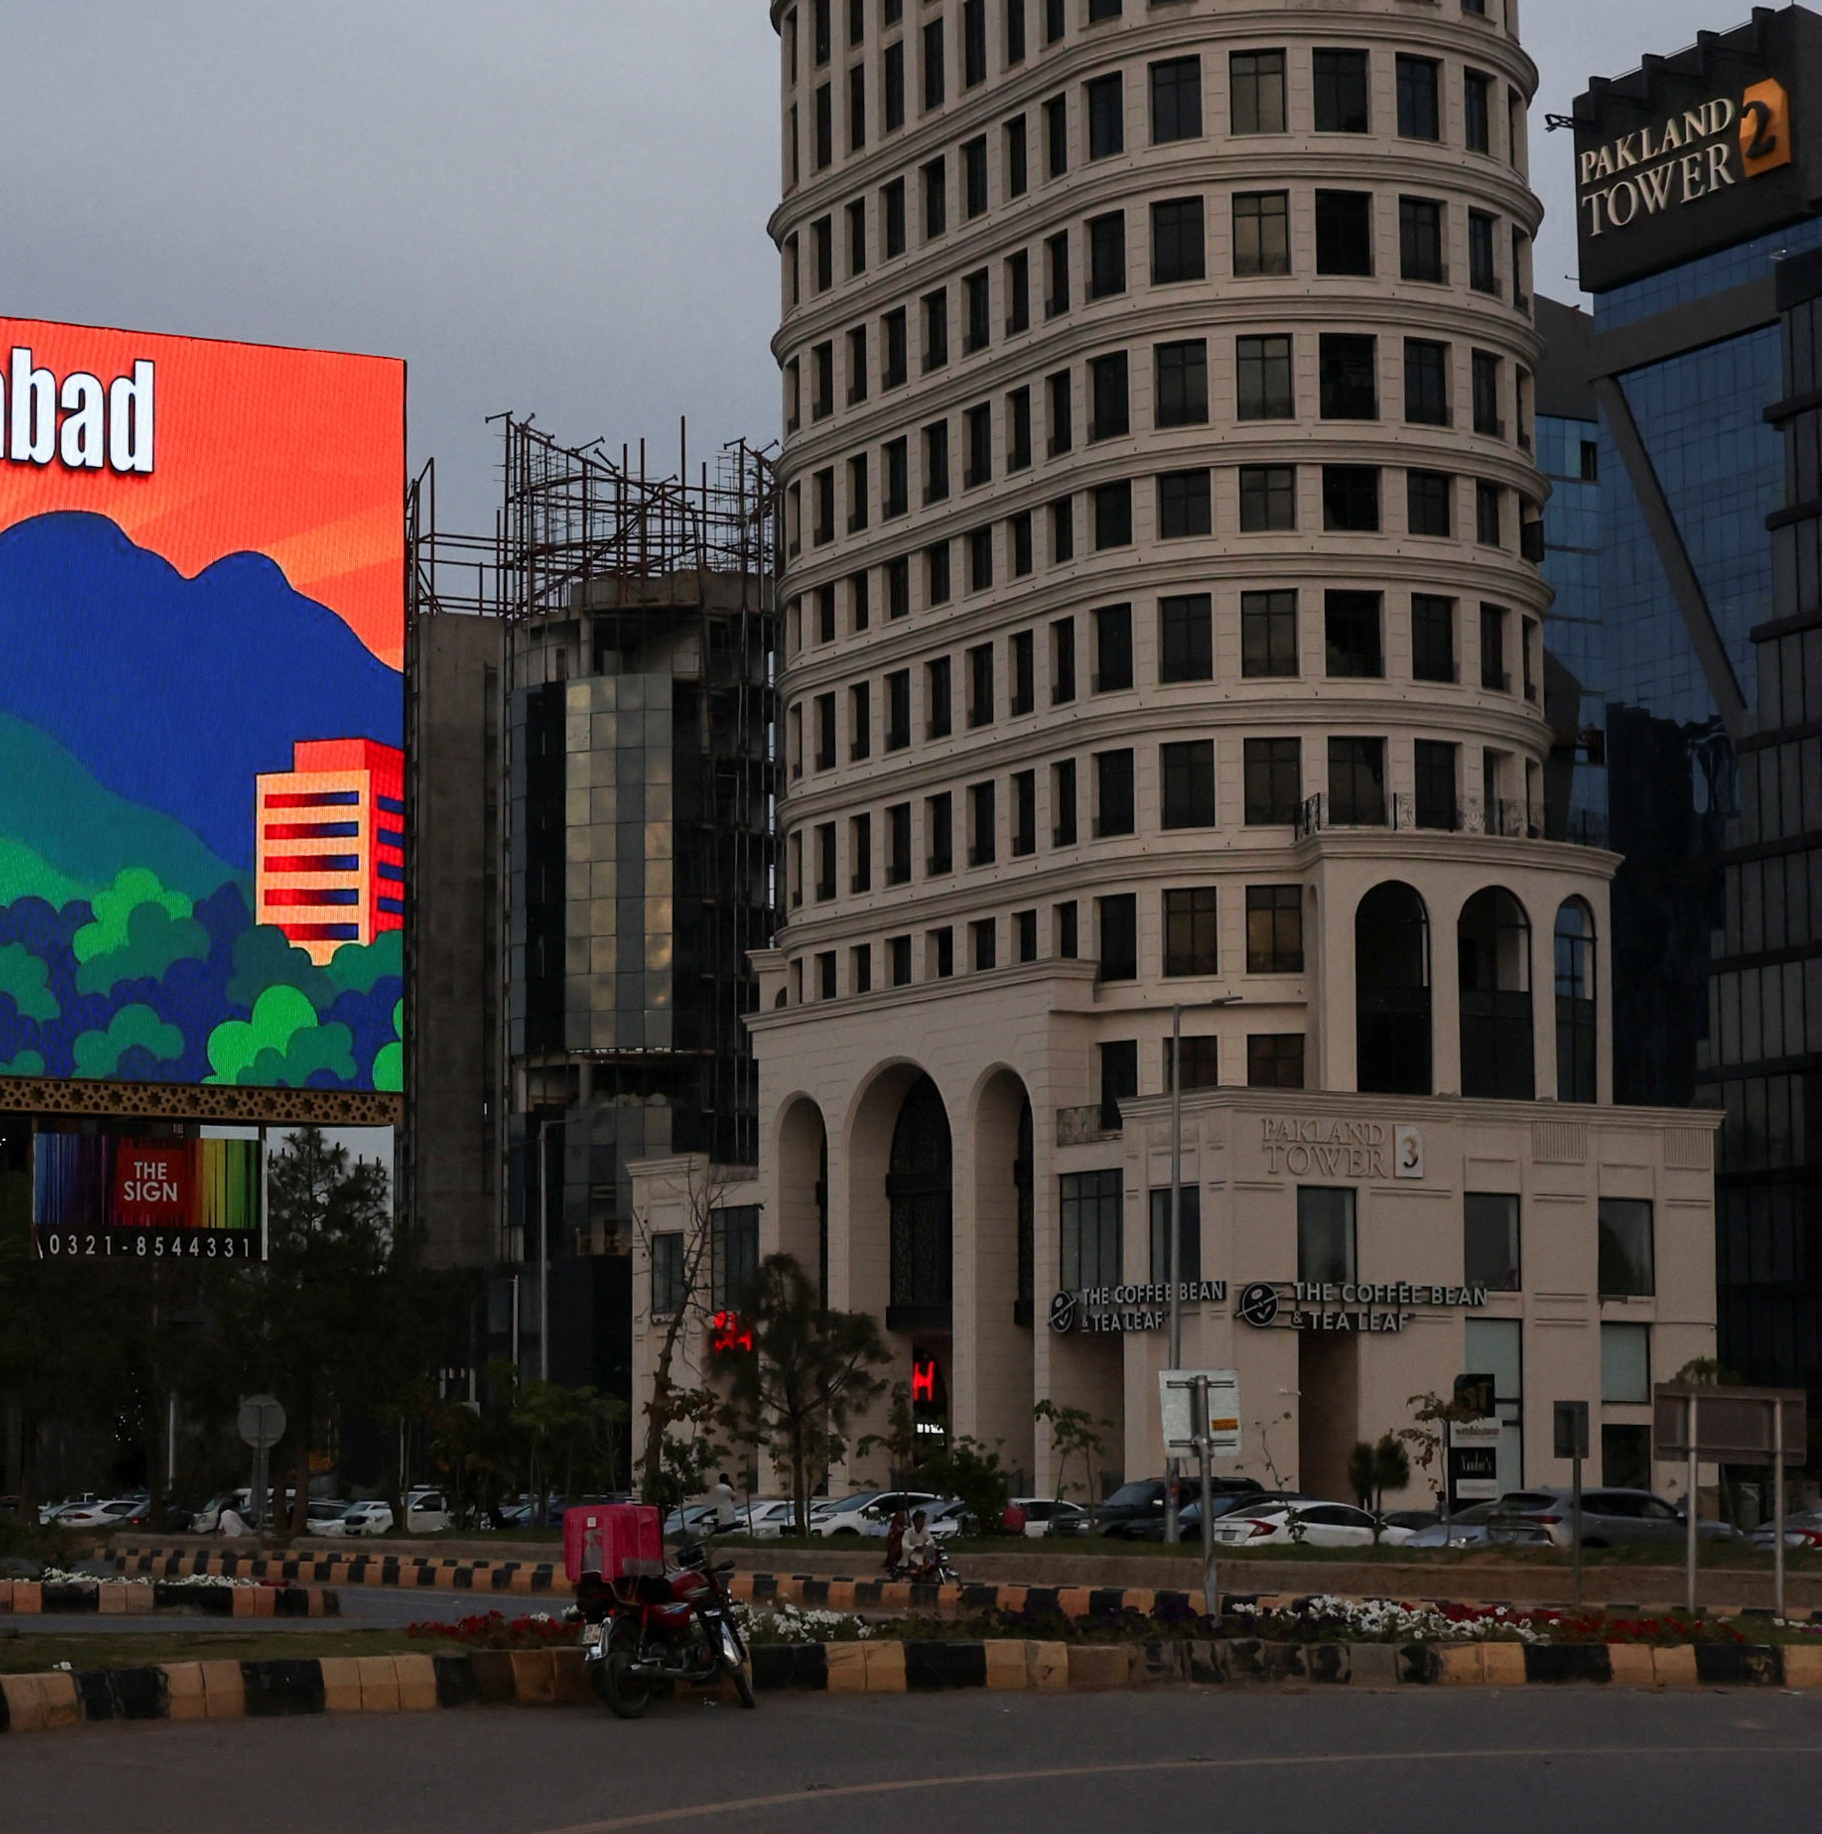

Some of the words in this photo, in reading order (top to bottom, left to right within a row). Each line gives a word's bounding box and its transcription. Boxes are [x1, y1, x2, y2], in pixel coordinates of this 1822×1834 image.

[1580, 98, 1735, 185] PAKLAND
[1741, 100, 1776, 158] 2
[1582, 142, 1736, 236] TOWER
[1262, 1119, 1385, 1147] PAKLAND
[1262, 1144, 1388, 1178] TOWER
[1403, 1135, 1419, 1168] 3
[134, 1161, 167, 1180] THE
[123, 1181, 178, 1202] SIGN
[49, 1234, 249, 1258] 0321-8544331
[1082, 1287, 1109, 1306] THE
[1114, 1284, 1171, 1304] COFFEE
[1179, 1281, 1224, 1301] BEAN
[1292, 1282, 1333, 1301] THE
[1341, 1284, 1422, 1304] COFFEE
[1431, 1286, 1488, 1306] BEAN
[1093, 1313, 1121, 1332] TEA
[1124, 1311, 1164, 1331] LEAF
[1309, 1312, 1350, 1330] TEA
[1358, 1313, 1409, 1332] LEAF
